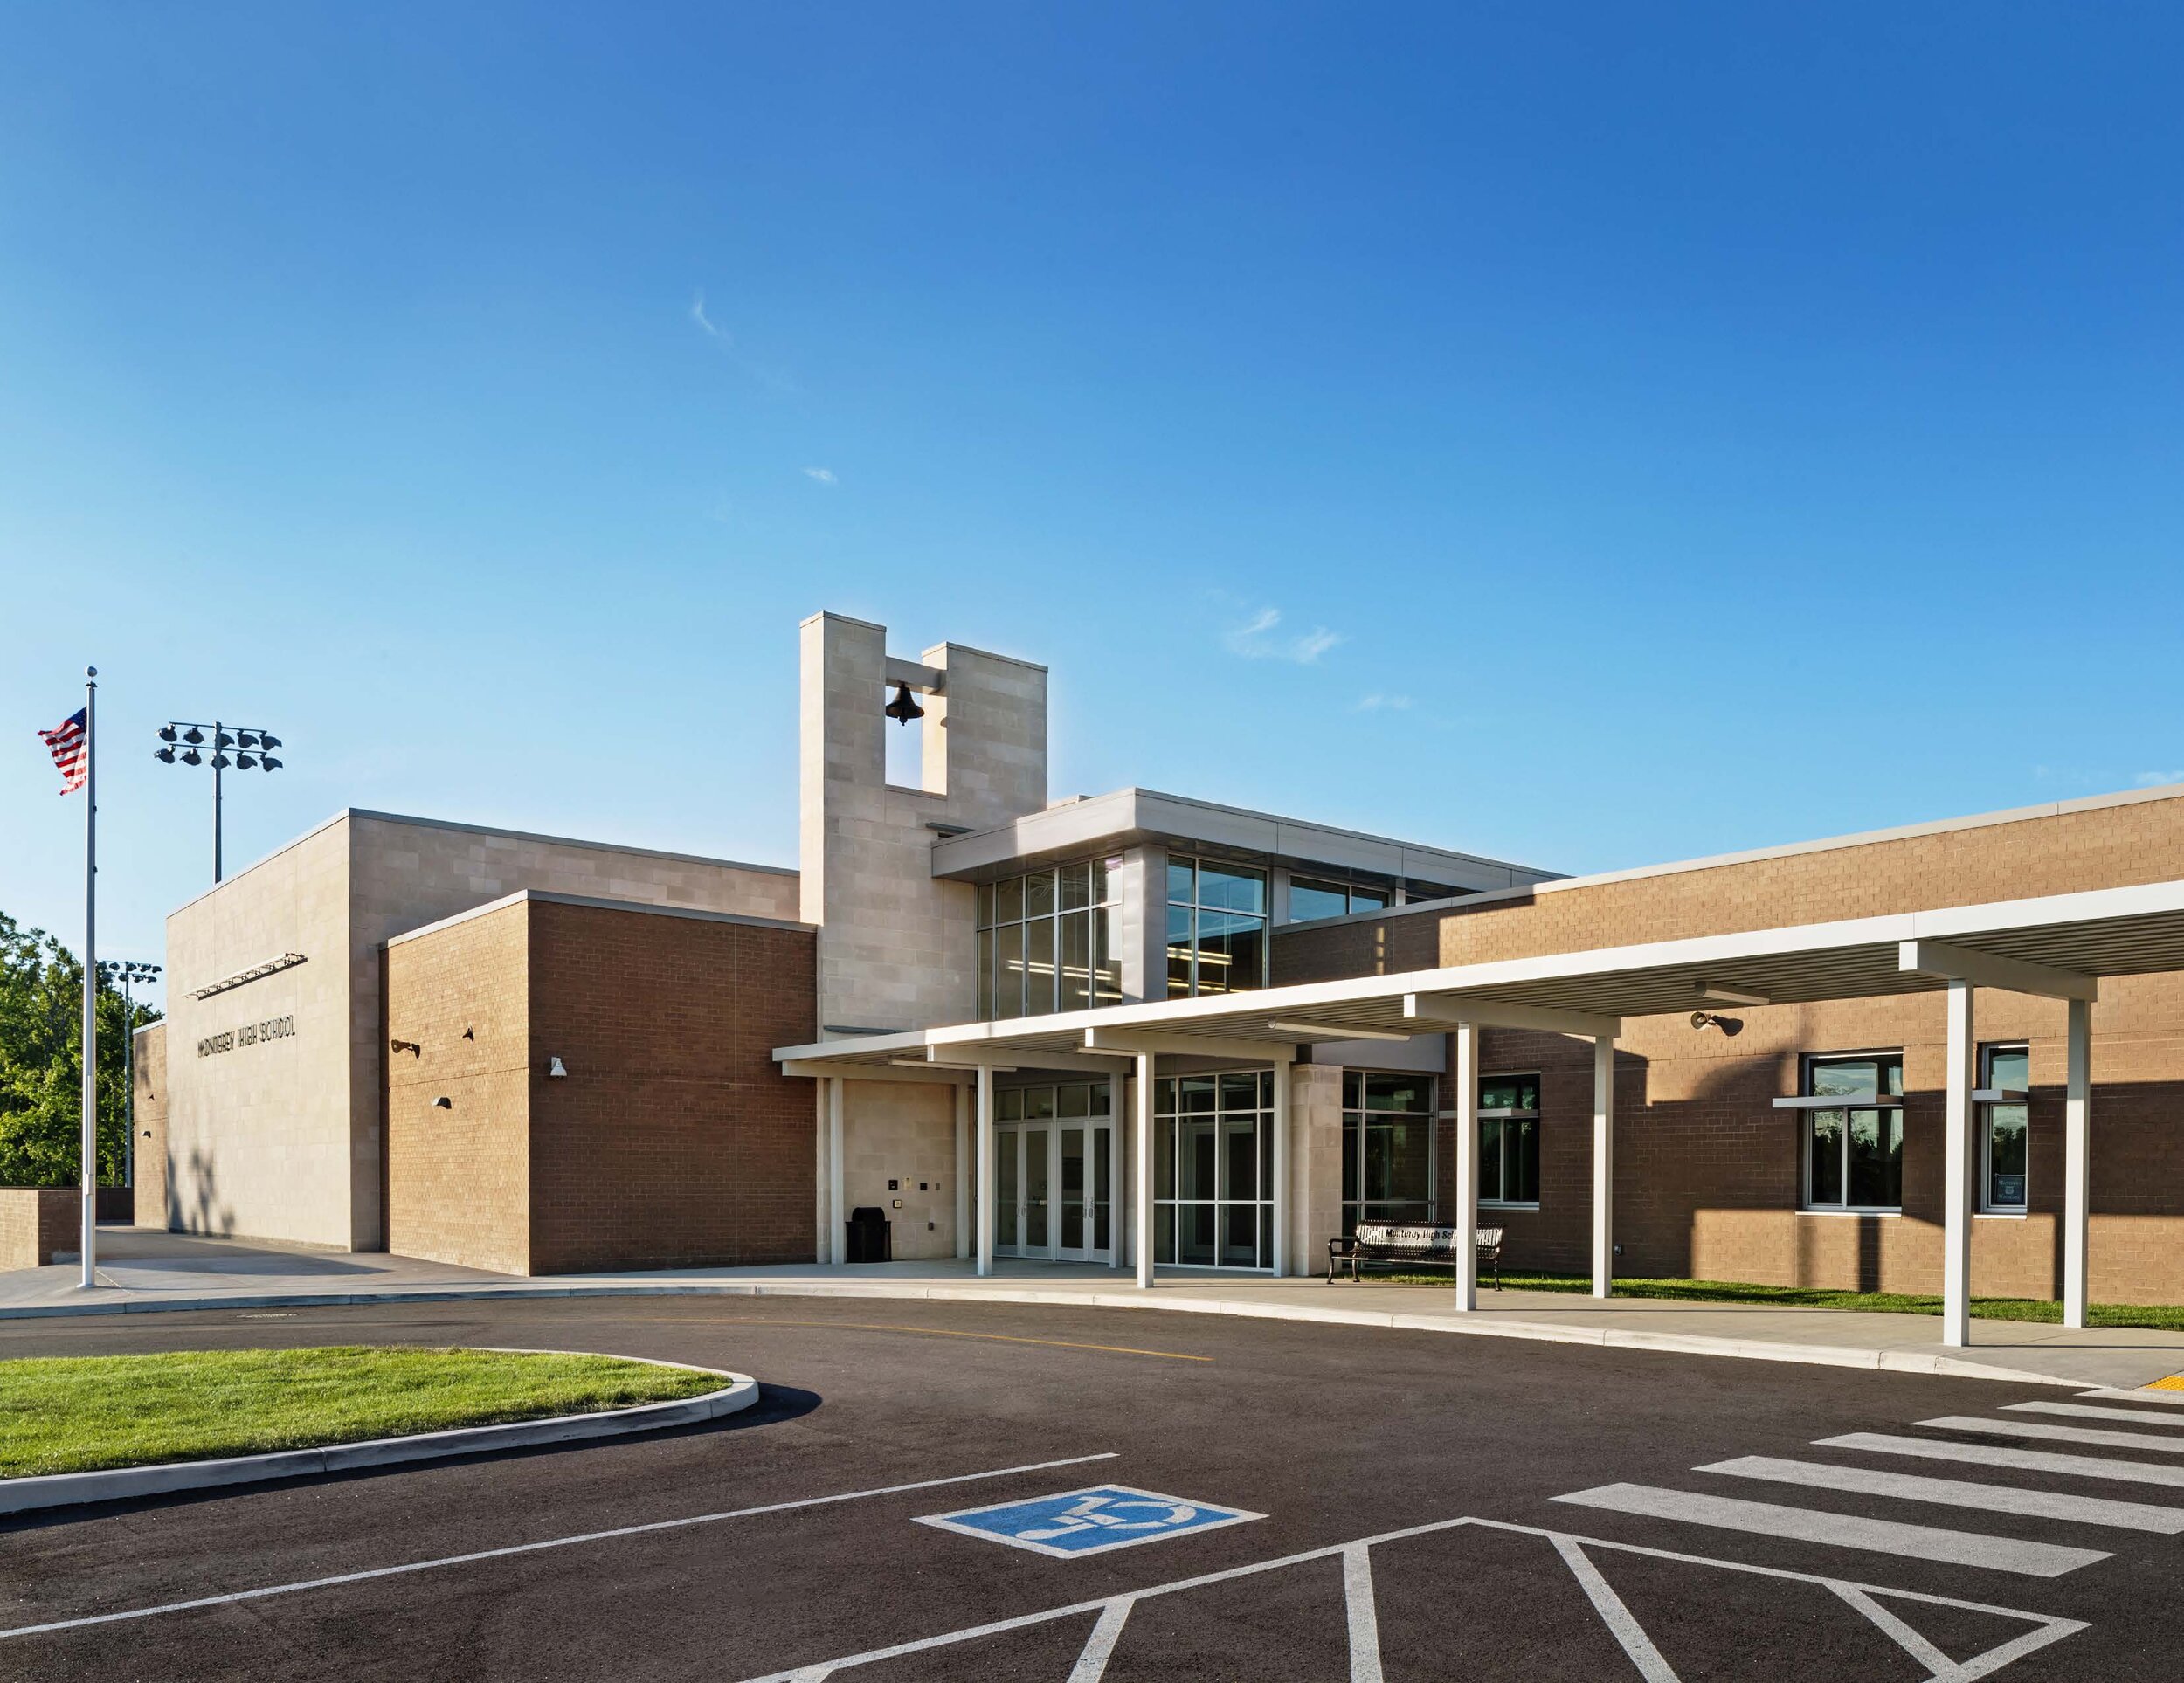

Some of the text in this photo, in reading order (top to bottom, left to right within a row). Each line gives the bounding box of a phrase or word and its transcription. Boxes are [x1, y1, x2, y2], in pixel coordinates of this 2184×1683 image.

[197, 1015, 295, 1059] MONTEREY HIGH SCHOOL
[1386, 1228, 1420, 1240] Monterey
[1423, 1230, 1441, 1241] High
